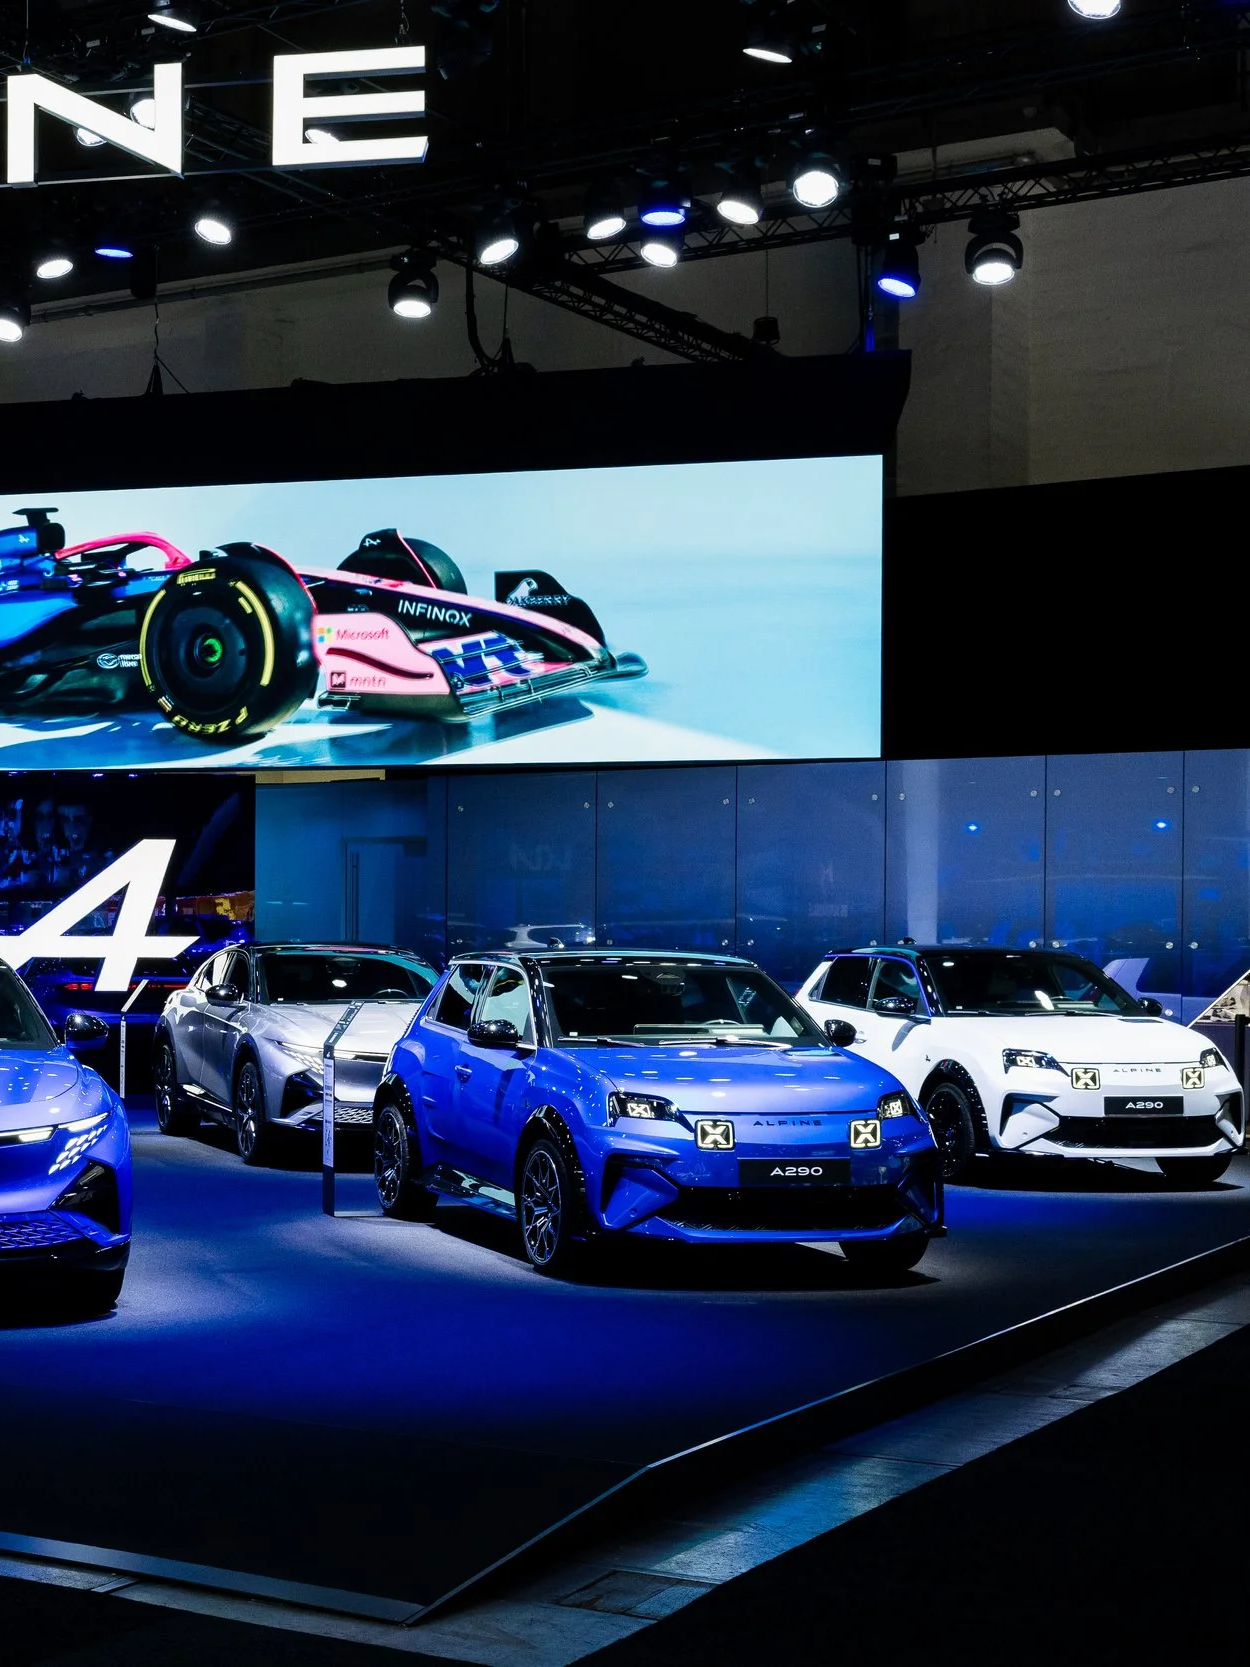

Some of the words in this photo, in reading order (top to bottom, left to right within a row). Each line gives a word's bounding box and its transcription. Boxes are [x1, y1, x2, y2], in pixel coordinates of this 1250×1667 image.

[397, 599, 471, 628] INFINOX
[336, 628, 389, 640] Microsoft
[1125, 1101, 1163, 1109] A290
[770, 1166, 823, 1176] A290
